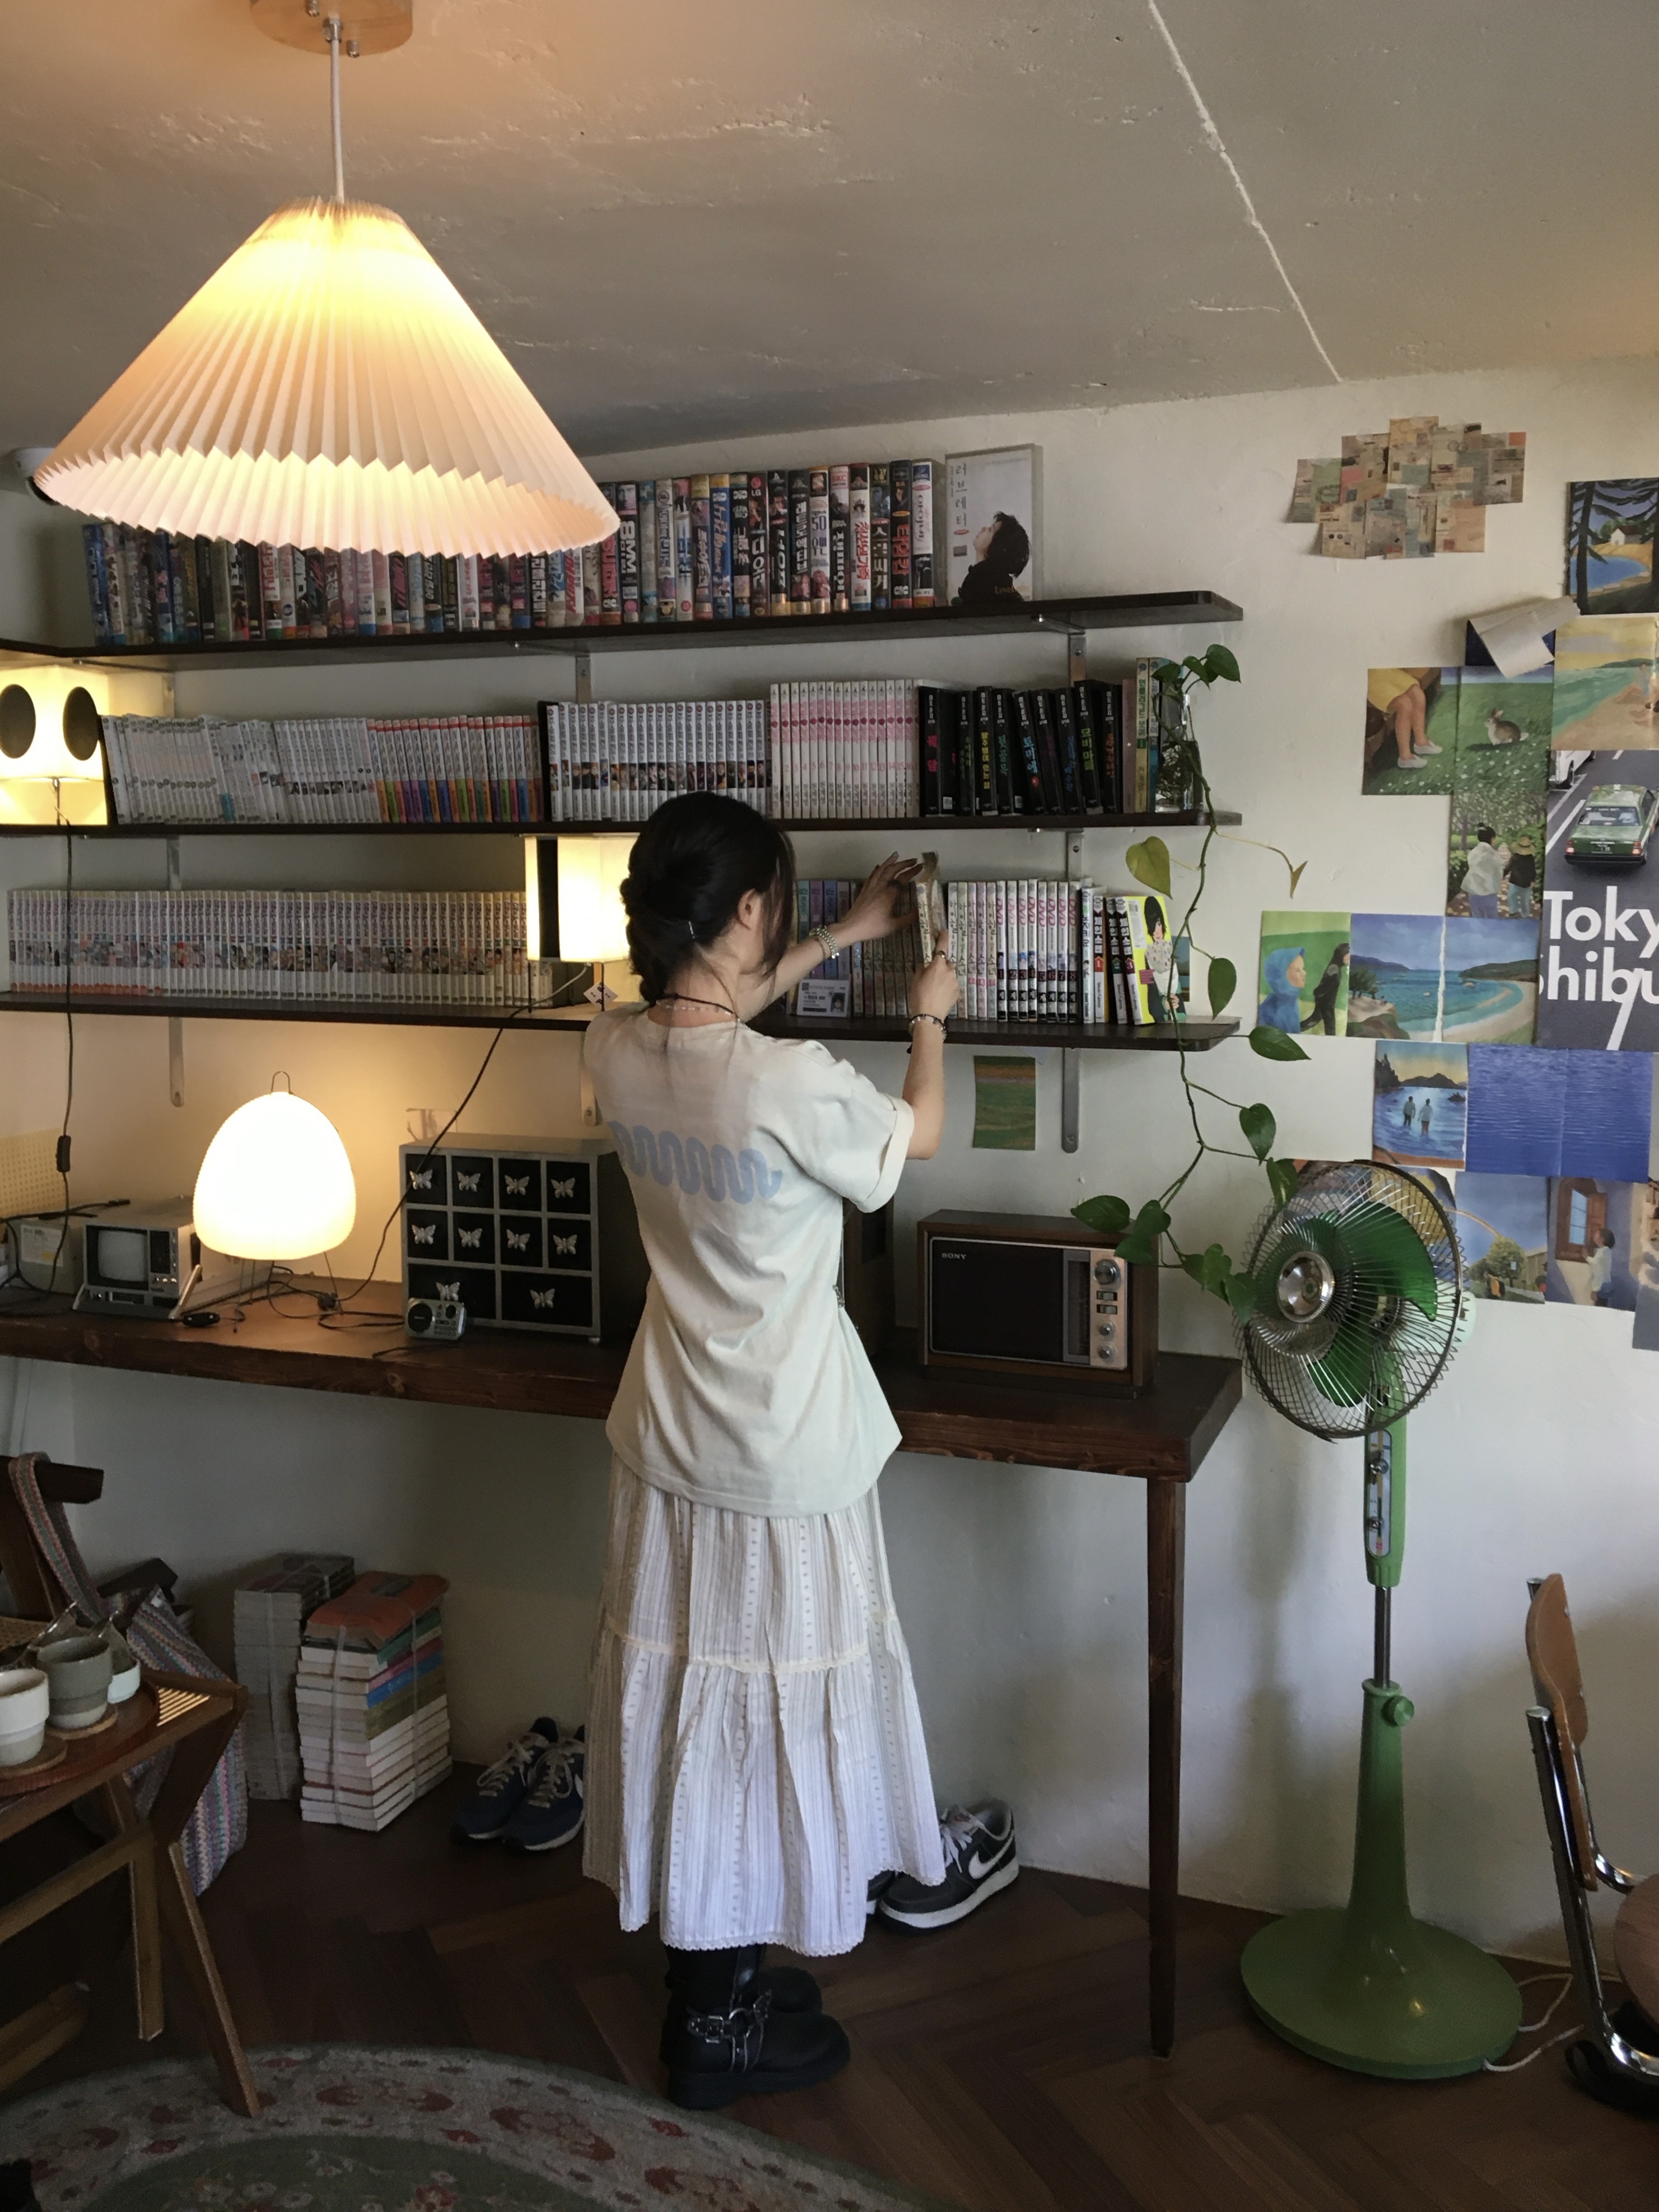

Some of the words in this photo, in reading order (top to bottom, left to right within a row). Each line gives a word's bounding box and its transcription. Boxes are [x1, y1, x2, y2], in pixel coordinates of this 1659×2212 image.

[956, 463, 967, 526] 러브레터
[621, 520, 637, 574] 8MM
[892, 524, 910, 574] 타임캅
[1023, 736, 1038, 774] 토미에
[999, 970, 1003, 979] 1
[1010, 971, 1016, 979] 2
[1020, 971, 1026, 980] 3
[1029, 968, 1035, 977] 4
[1038, 972, 1045, 981] 5
[1049, 972, 1055, 980] 6
[1059, 972, 1065, 980] 7
[1070, 971, 1076, 980] 8
